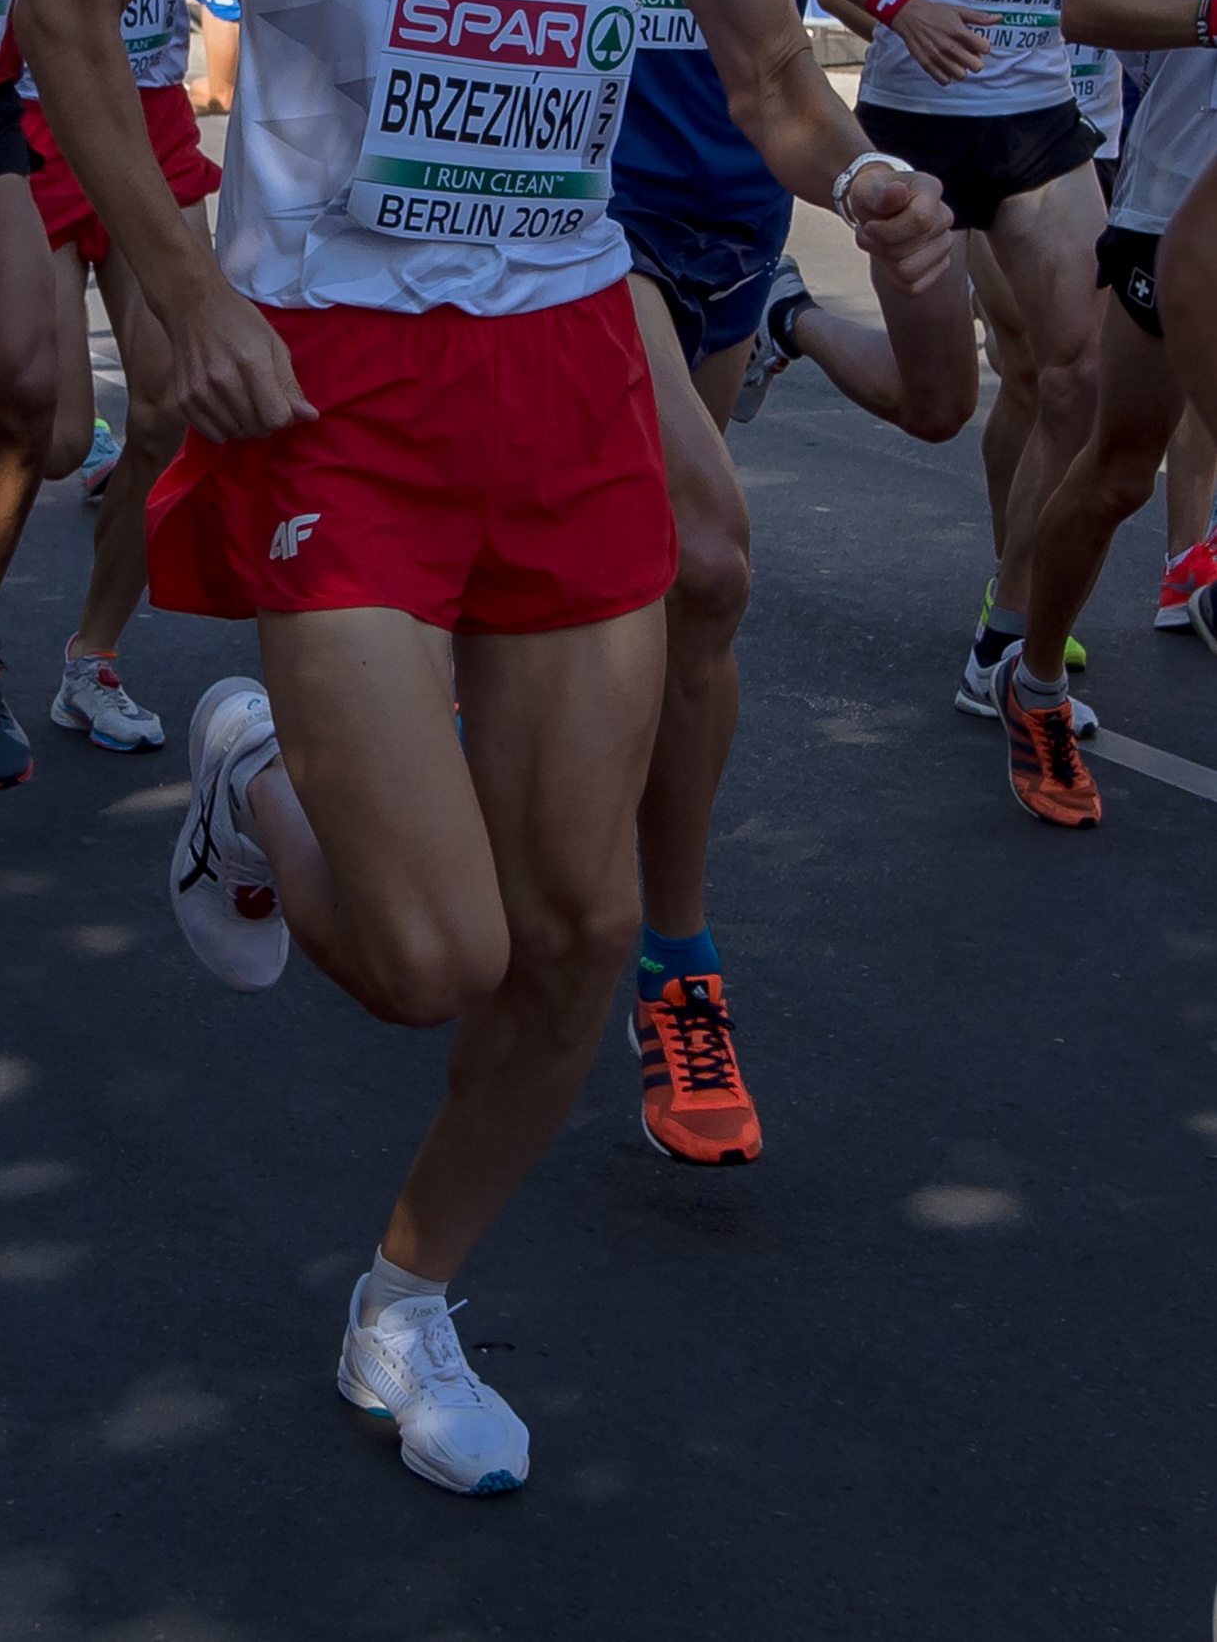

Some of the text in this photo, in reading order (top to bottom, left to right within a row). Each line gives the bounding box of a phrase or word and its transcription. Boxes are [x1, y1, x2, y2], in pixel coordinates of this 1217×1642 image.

[380, 68, 594, 150] BRZEZIŃSKI
[437, 168, 485, 190] RUN
[375, 193, 585, 239] BERLIN 2018
